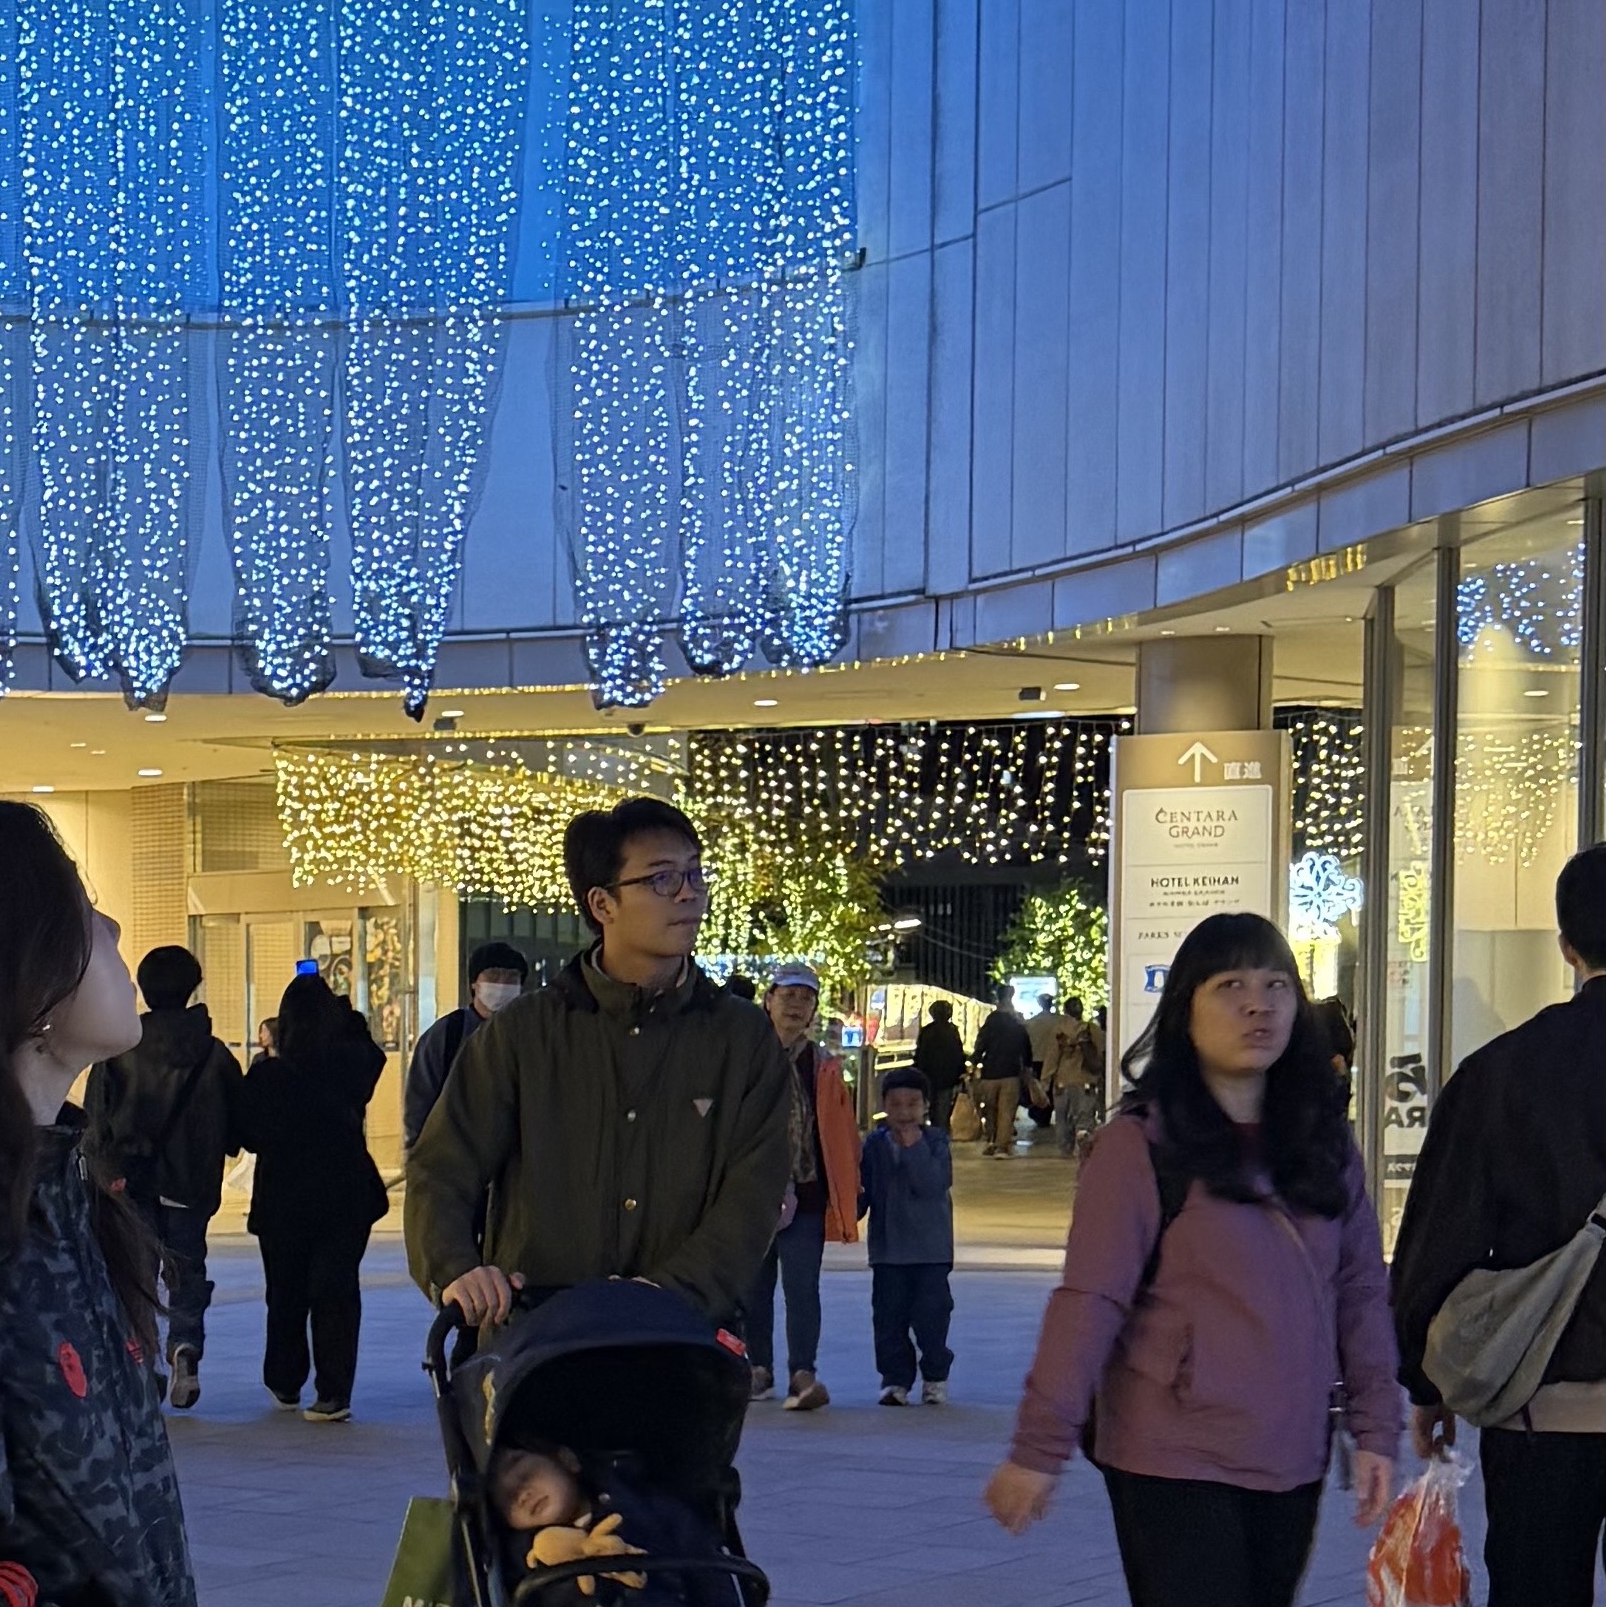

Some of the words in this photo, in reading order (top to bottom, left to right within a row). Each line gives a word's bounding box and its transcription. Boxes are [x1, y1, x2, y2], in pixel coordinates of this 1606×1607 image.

[1155, 807, 1238, 824] CENTARA
[1168, 825, 1225, 839] GRAND
[1151, 877, 1190, 888] HOTEL
[1193, 875, 1239, 887] KEIHAN
